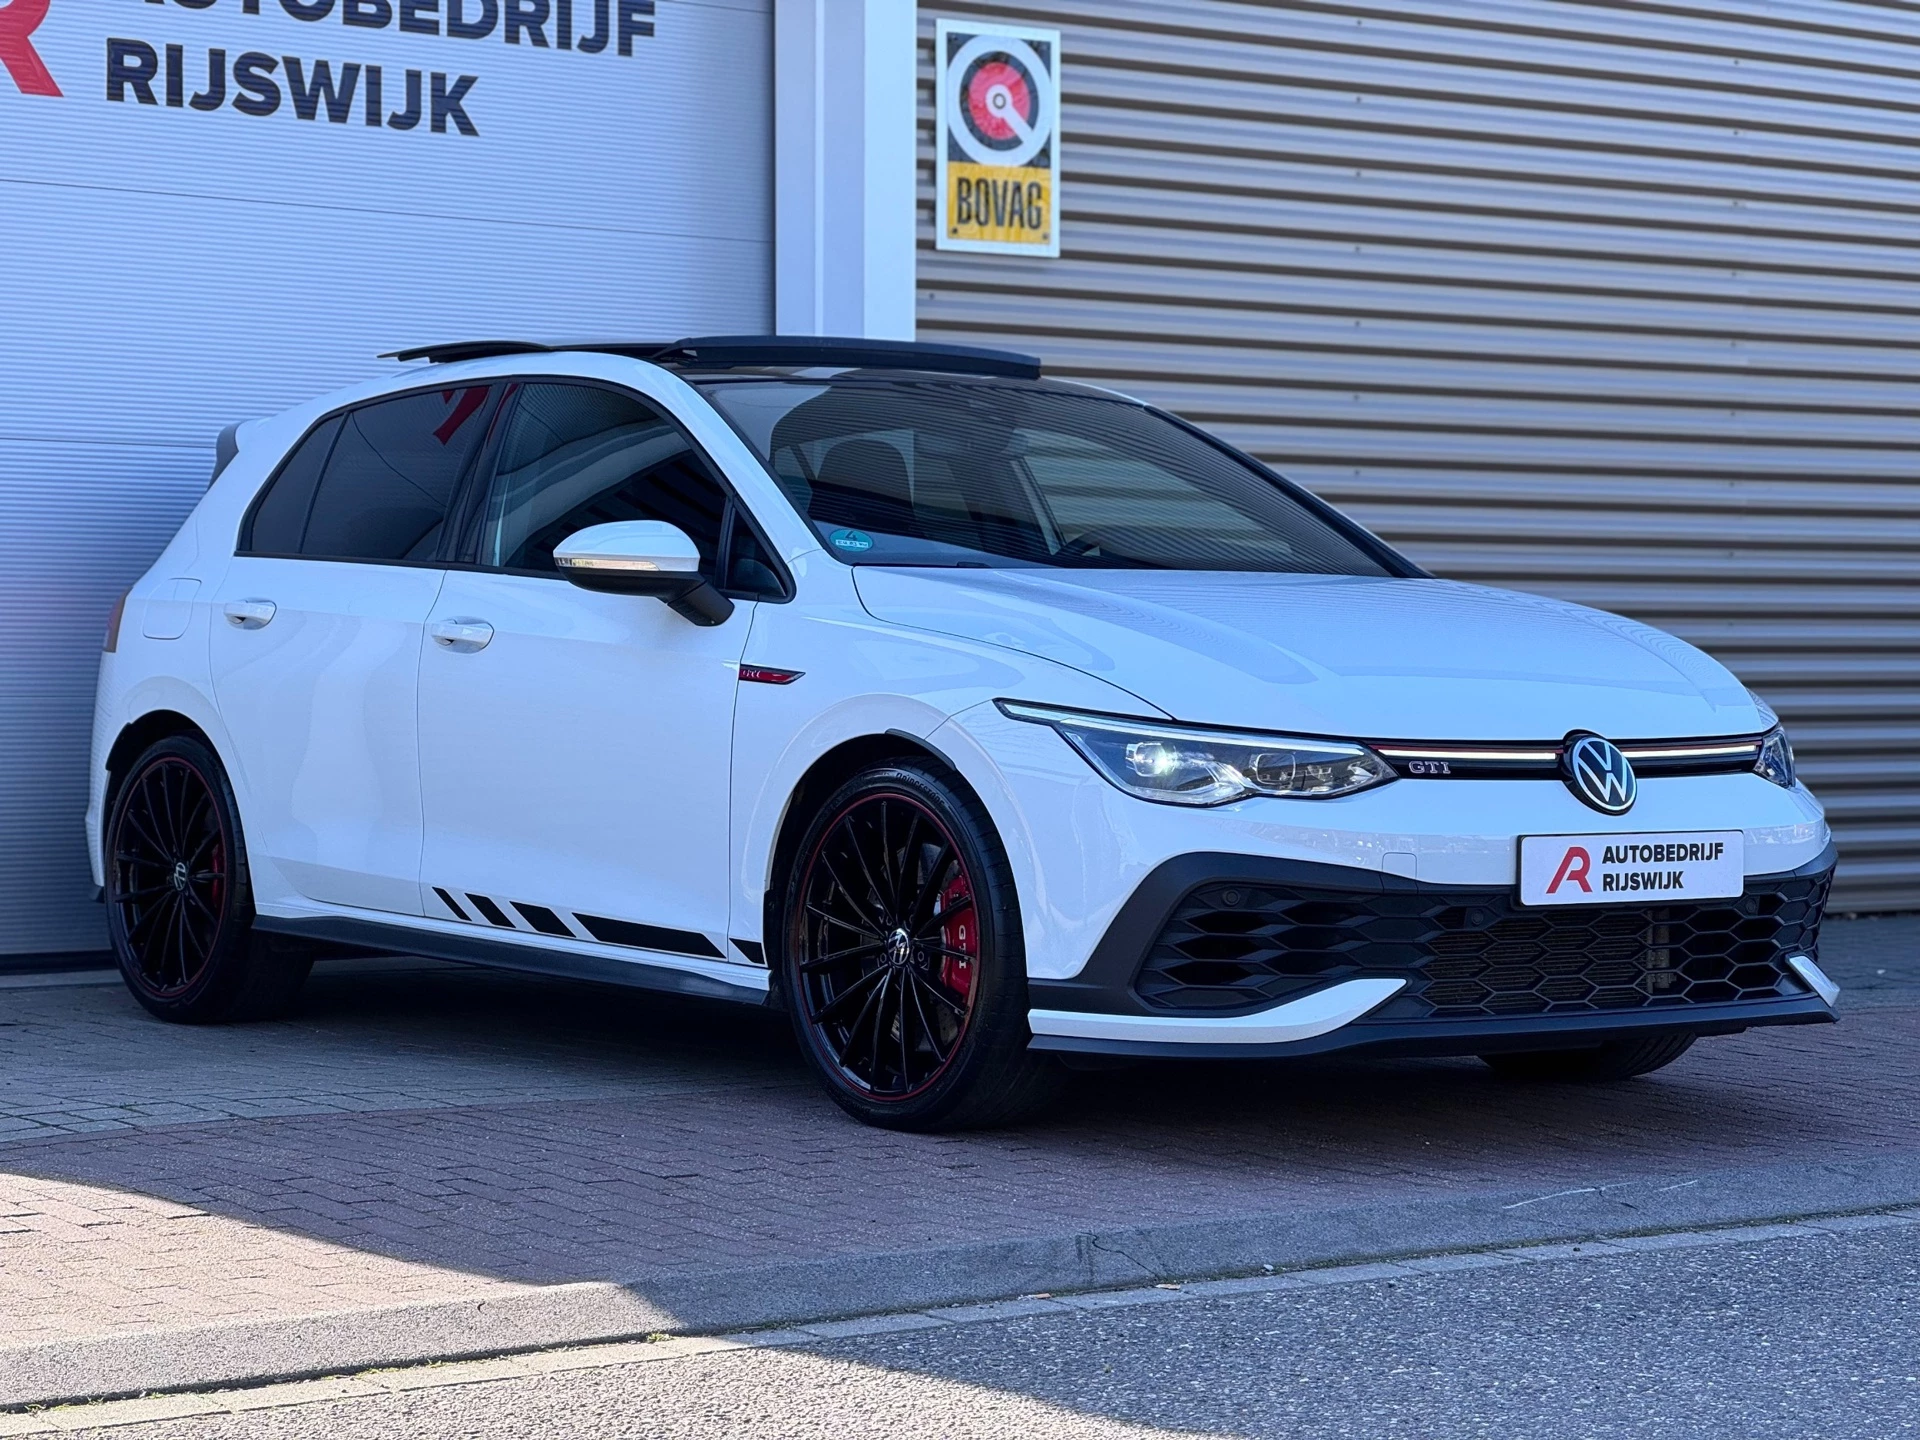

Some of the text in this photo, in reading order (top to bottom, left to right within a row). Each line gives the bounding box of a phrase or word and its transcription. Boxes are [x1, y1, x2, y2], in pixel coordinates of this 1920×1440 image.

[145, 0, 655, 57] EDRIJF
[106, 37, 480, 137] RIJSWIJK
[957, 176, 1043, 231] BOVAG
[1408, 760, 1451, 774] GTI
[1602, 842, 1724, 865] AUTOBEDRIJF
[1603, 871, 1684, 892] RIJSWIJK
